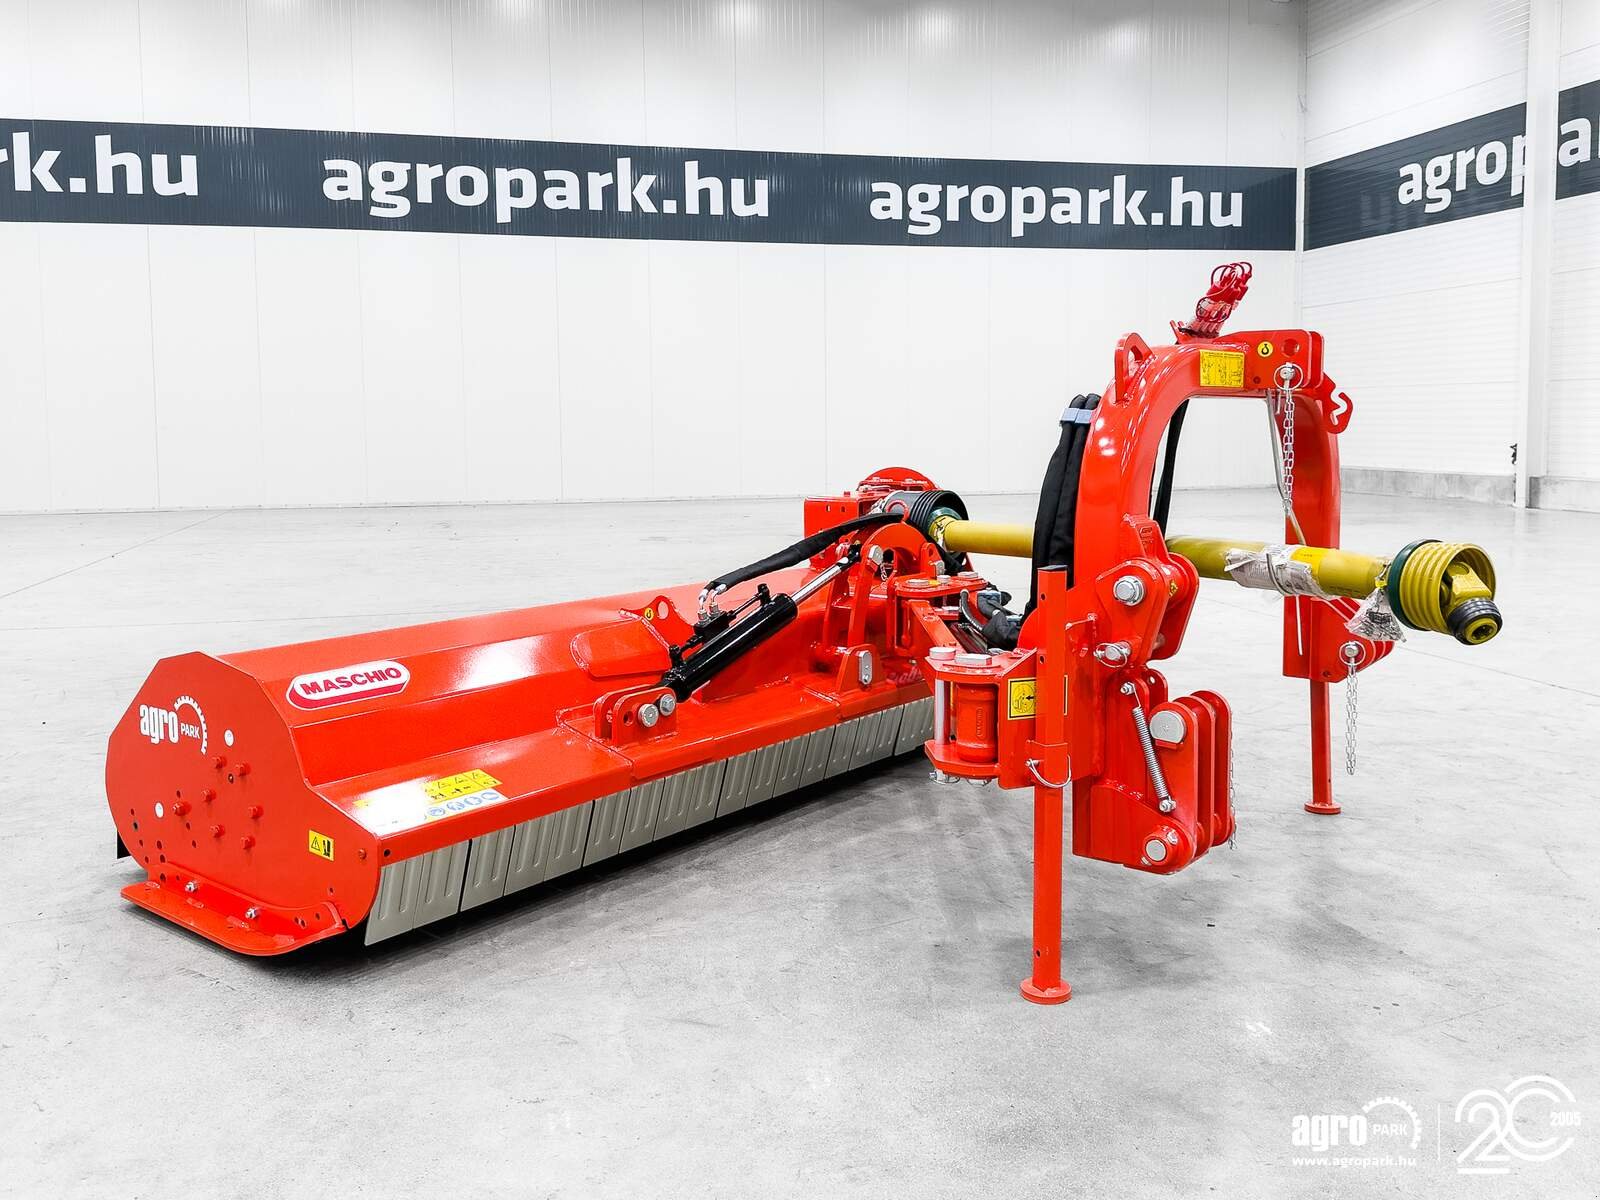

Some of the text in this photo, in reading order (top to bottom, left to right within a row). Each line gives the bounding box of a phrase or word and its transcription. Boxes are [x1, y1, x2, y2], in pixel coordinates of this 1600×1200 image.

[0, 131, 199, 196] k.hu
[322, 157, 769, 224] agropark.hu
[869, 174, 1243, 238] agropark.hu
[300, 667, 402, 695] MASCHIO
[139, 704, 201, 744] agro PARK
